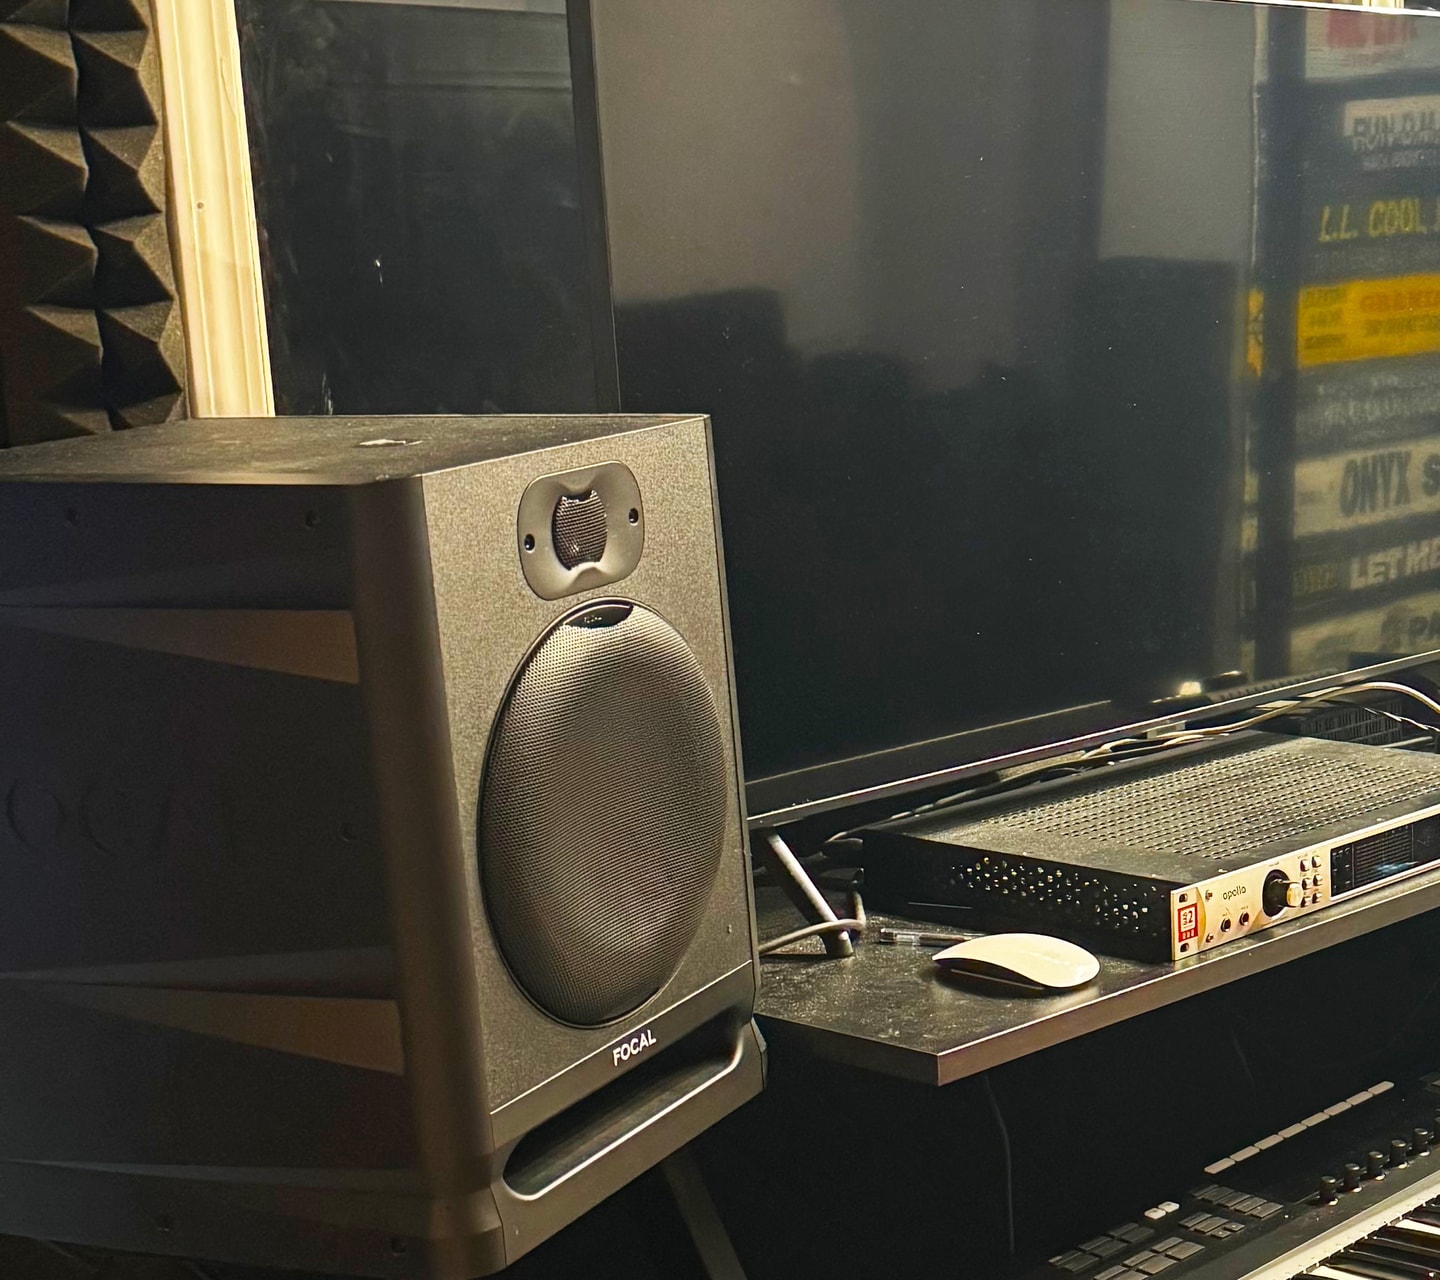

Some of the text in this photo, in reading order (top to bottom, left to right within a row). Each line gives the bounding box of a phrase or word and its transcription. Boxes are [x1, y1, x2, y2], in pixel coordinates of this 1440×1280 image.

[1368, 197, 1427, 238] COOL
[1339, 450, 1412, 517] ONYX
[1222, 885, 1247, 901] apollo
[612, 1029, 657, 1066] FOCAL
